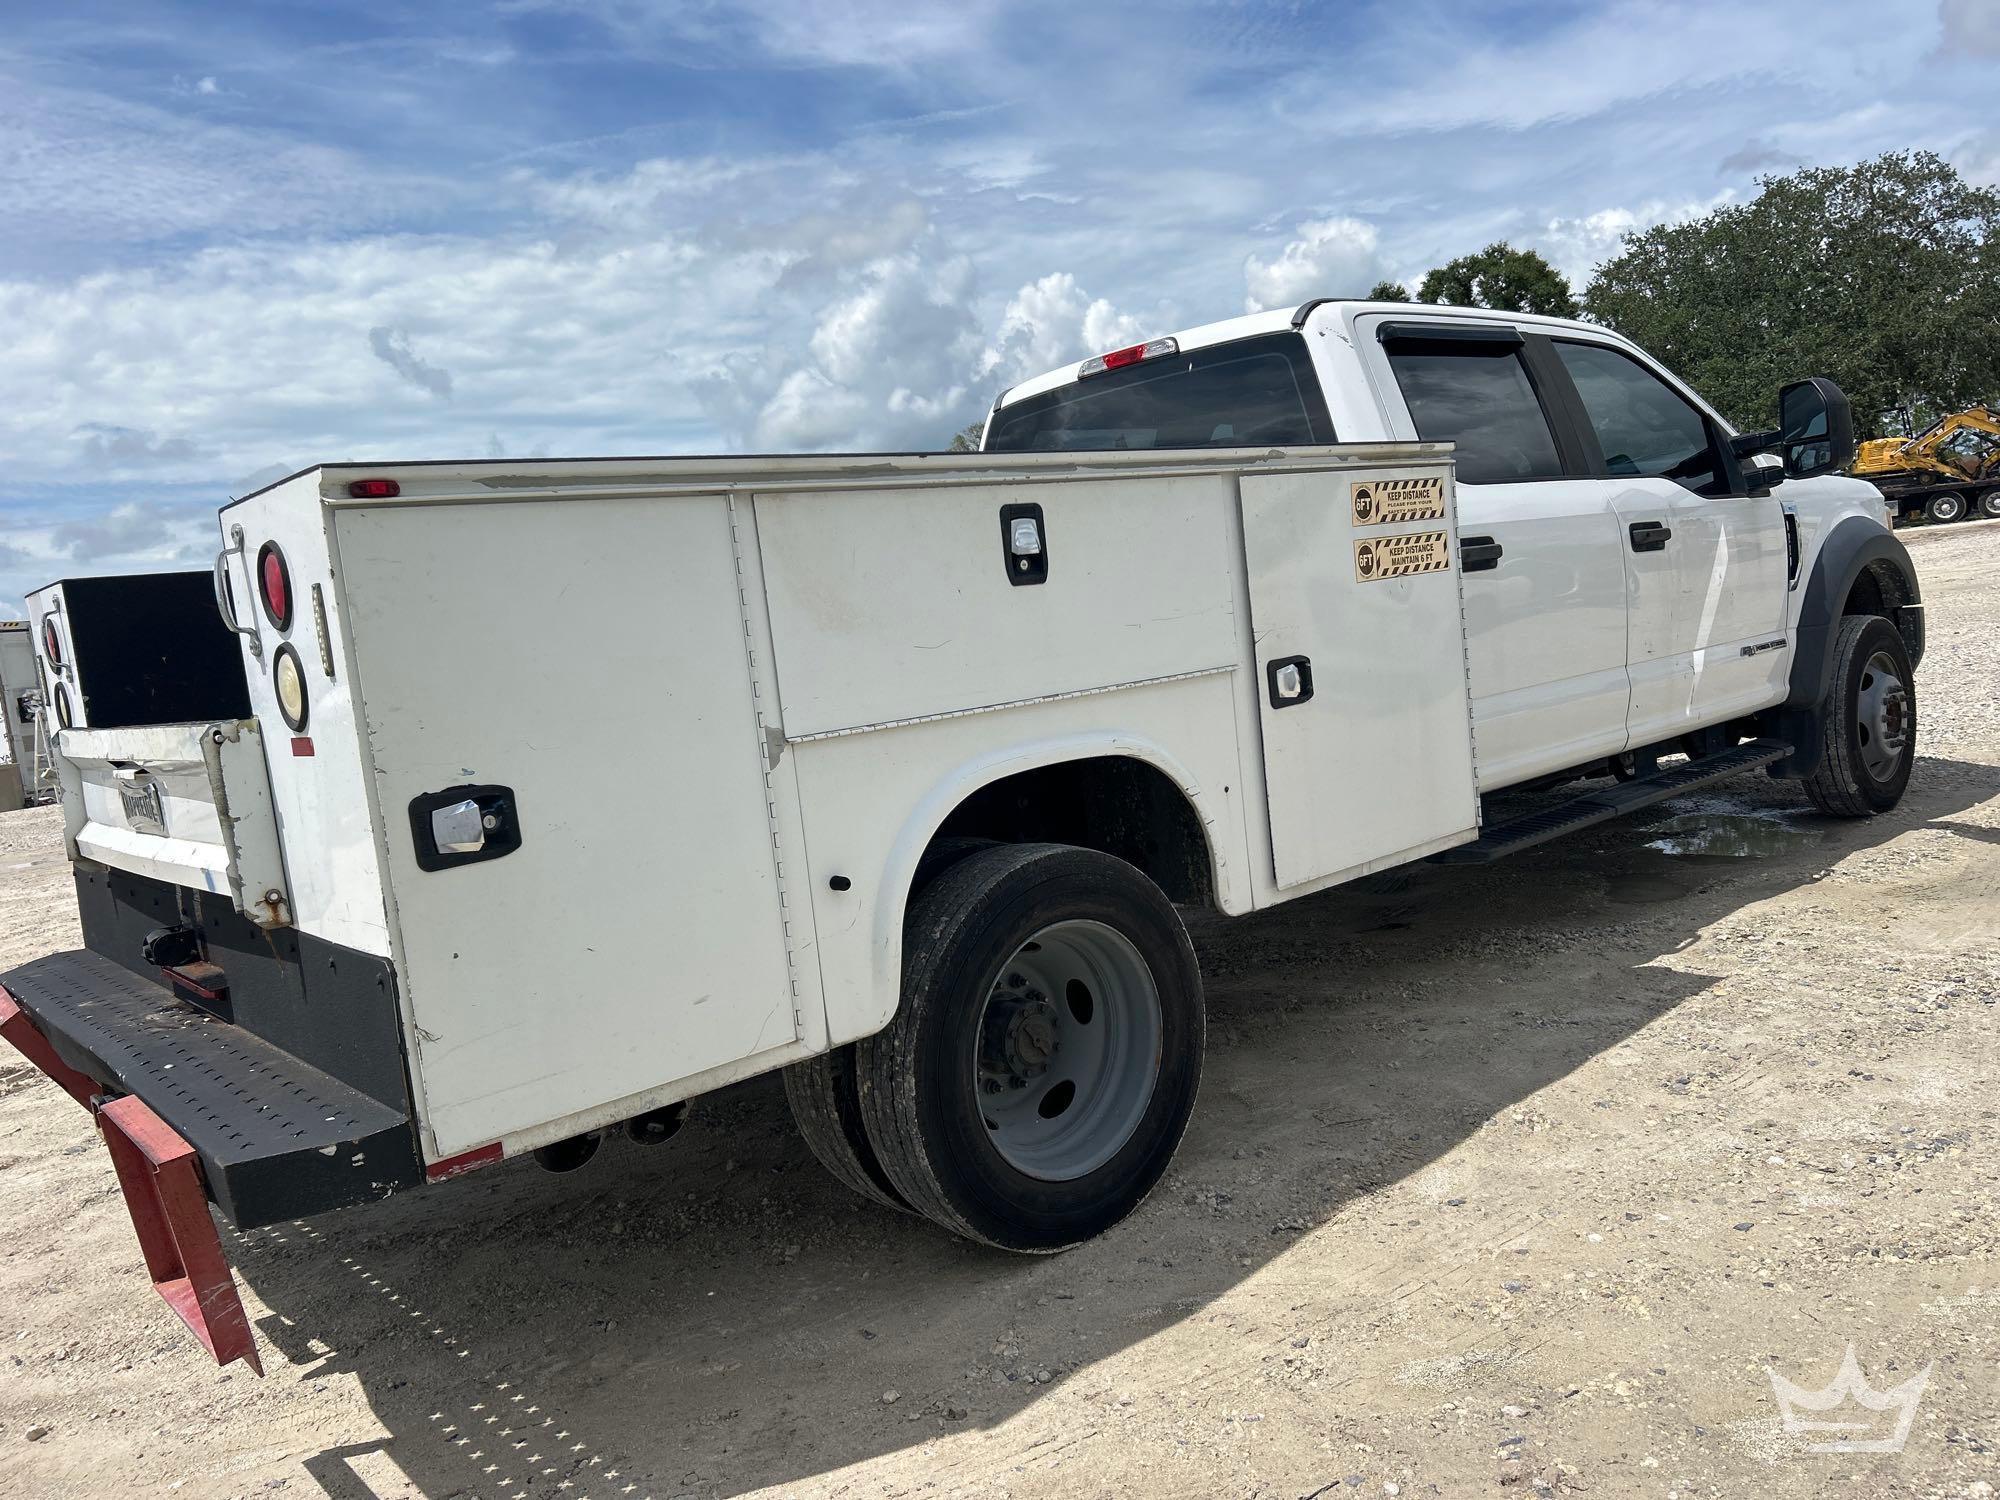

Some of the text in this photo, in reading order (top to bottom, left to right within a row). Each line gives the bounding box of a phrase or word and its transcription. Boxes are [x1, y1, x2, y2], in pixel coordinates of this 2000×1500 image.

[1387, 489, 1430, 501] KEEP DISTANCE
[1356, 497, 1371, 511] 6FT
[1389, 543, 1434, 557] KEEP DISTANCE
[1359, 553, 1373, 567] 6FT
[1391, 553, 1433, 566] MAINTAIN 6 FT
